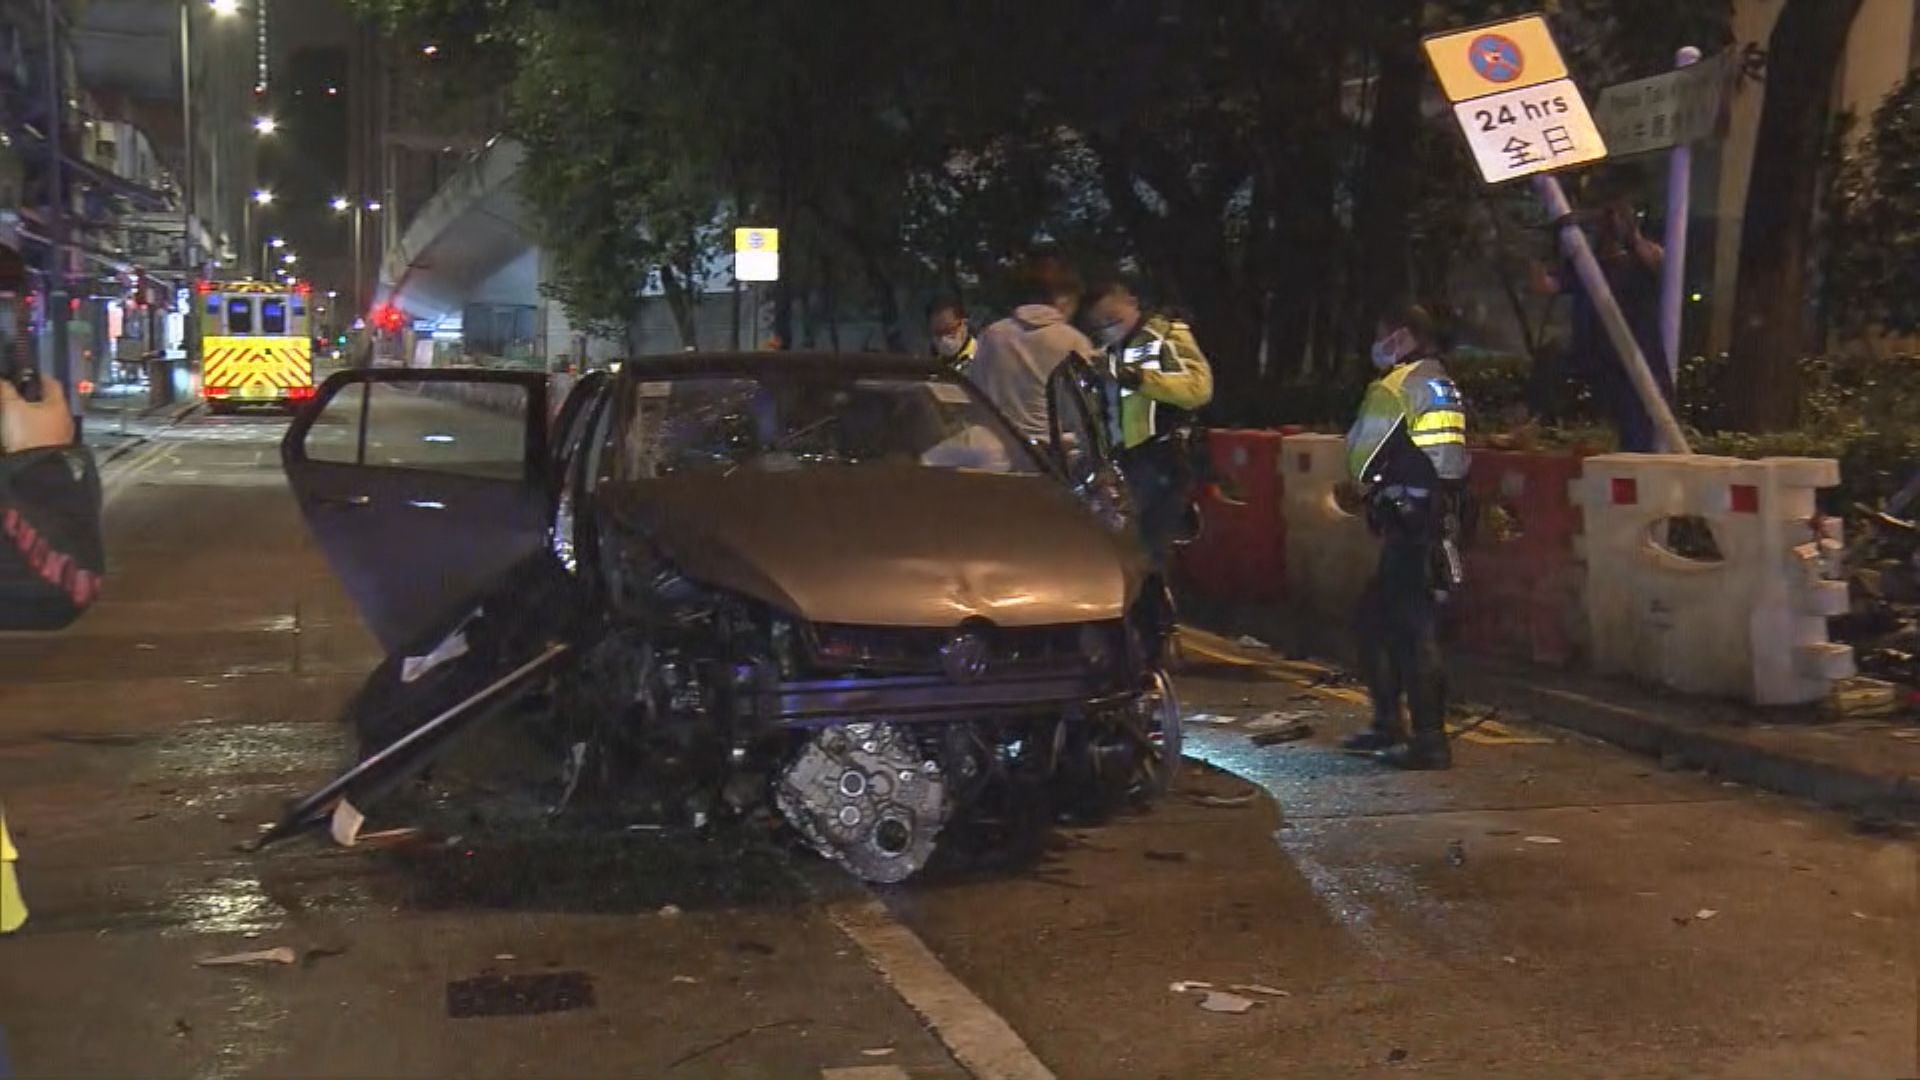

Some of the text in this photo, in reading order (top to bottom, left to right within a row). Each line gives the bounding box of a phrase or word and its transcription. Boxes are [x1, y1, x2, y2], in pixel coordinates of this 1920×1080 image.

[1475, 96, 1568, 132] 24 hrs
[1502, 126, 1575, 169] 全日
